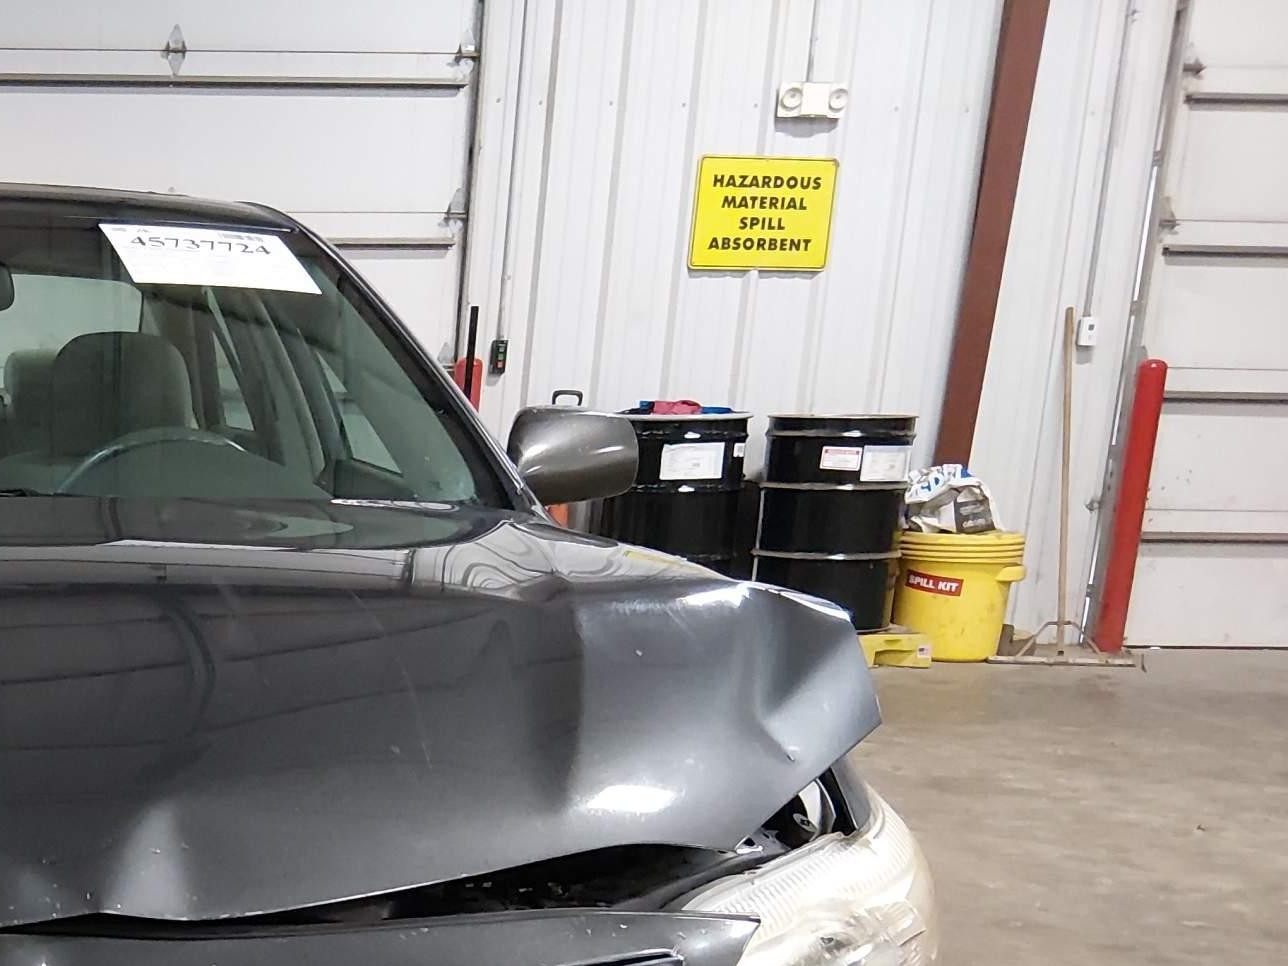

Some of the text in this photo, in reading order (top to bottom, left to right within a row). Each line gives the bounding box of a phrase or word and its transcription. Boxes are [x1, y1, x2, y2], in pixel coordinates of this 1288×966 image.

[712, 174, 822, 190] HAZARDOUS
[721, 196, 808, 210] MATERIAL
[738, 217, 786, 231] SPILL
[130, 236, 271, 255] 45737724
[707, 237, 812, 252] ABSORBENT
[908, 574, 960, 592] SPILL KIT
